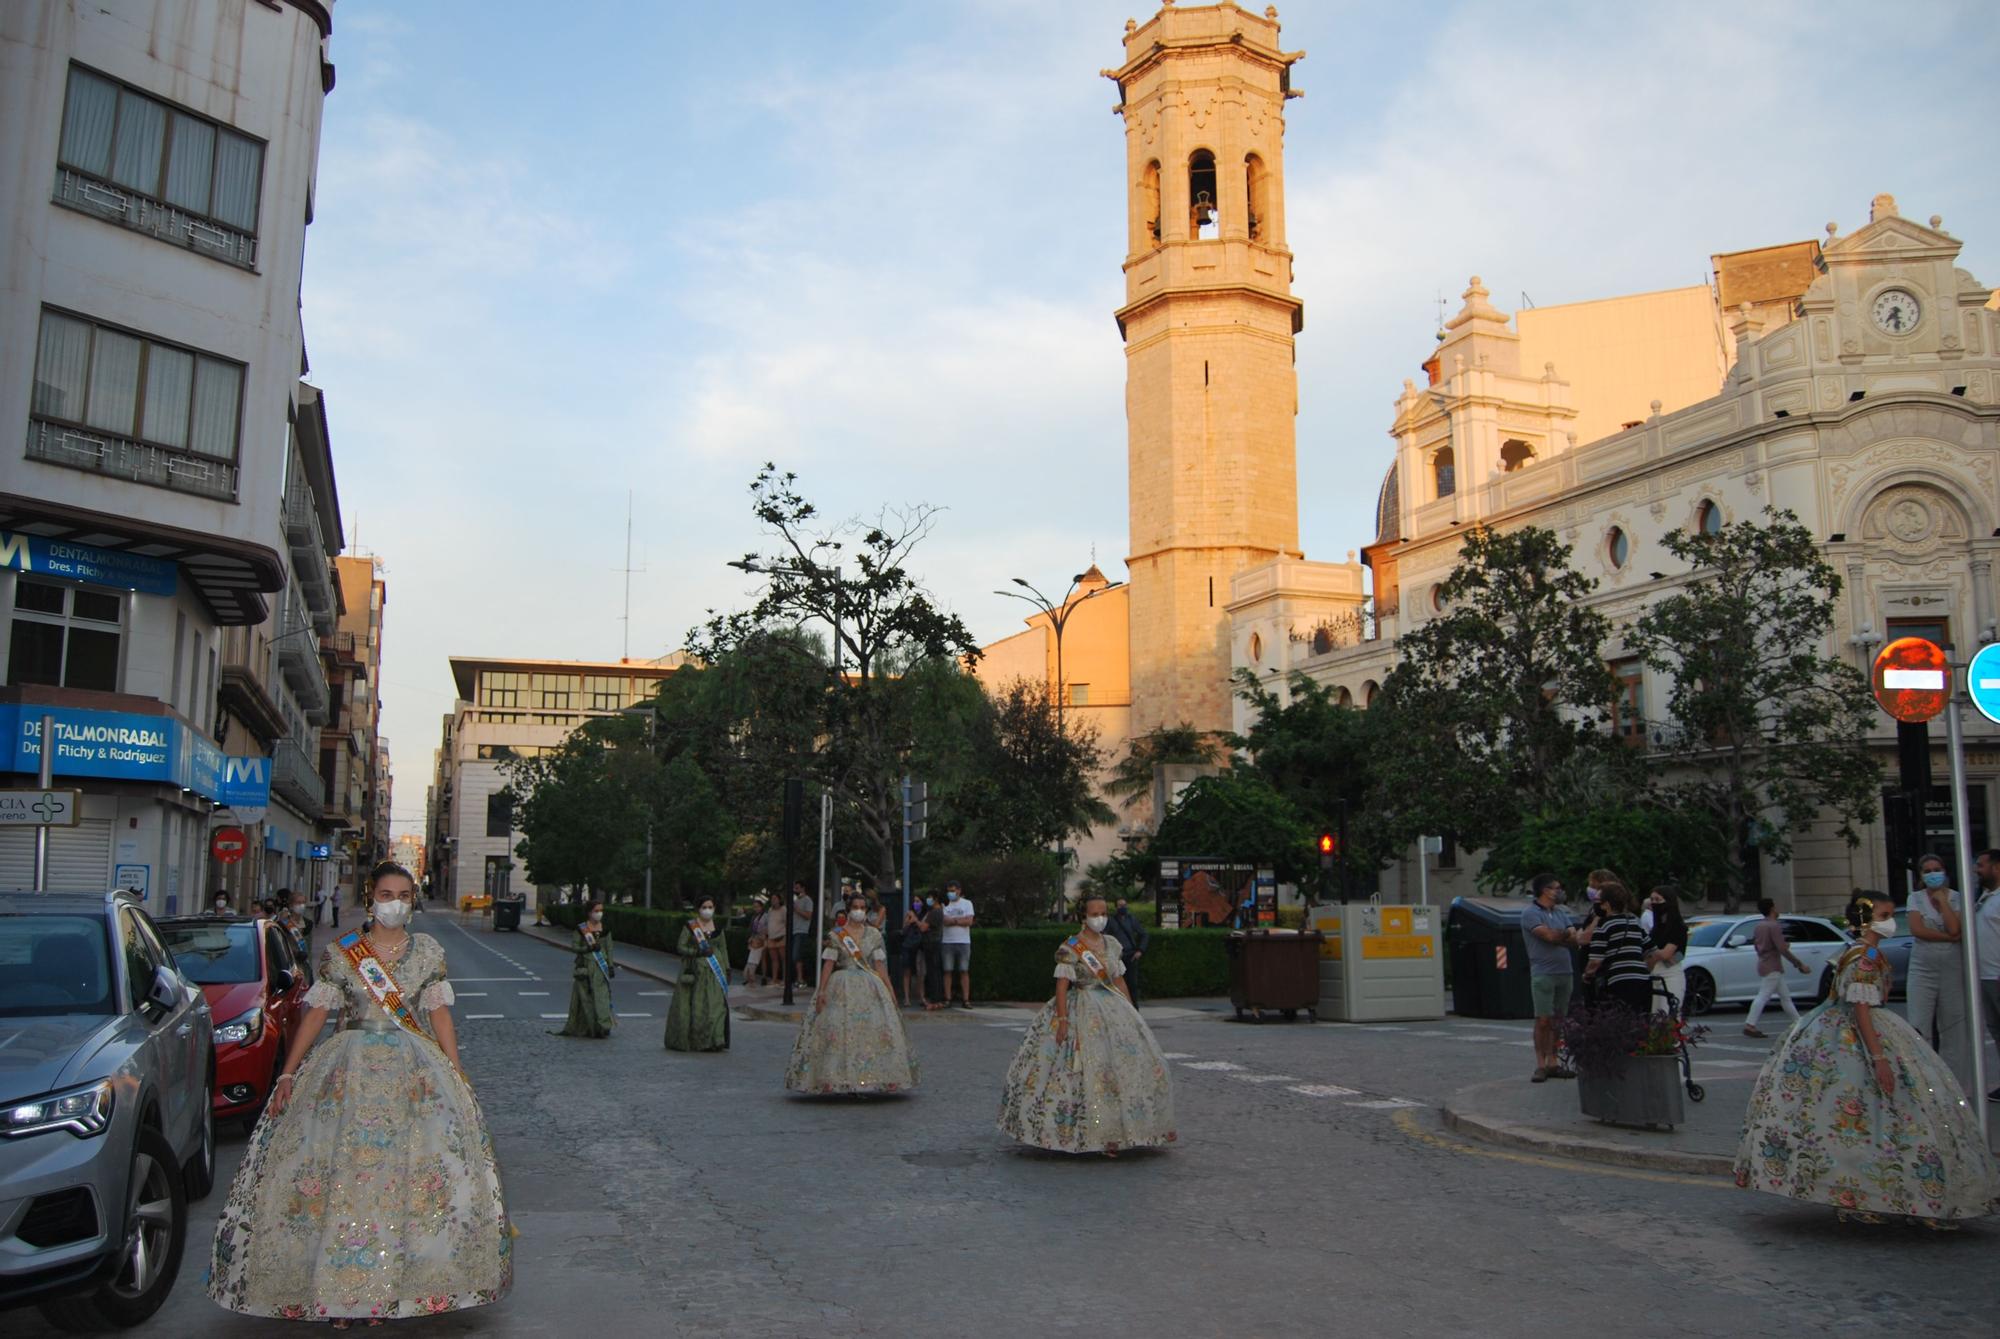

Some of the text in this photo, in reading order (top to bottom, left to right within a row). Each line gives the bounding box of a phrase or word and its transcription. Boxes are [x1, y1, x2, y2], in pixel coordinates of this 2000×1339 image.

[48, 560, 74, 573] Dres.
[77, 564, 105, 580] Flichy
[23, 721, 168, 748] DETALMONRABAL
[58, 744, 95, 760] Flichy
[98, 750, 107, 759] &
[110, 748, 166, 764] Rodríguez
[0, 812, 27, 820] reno
